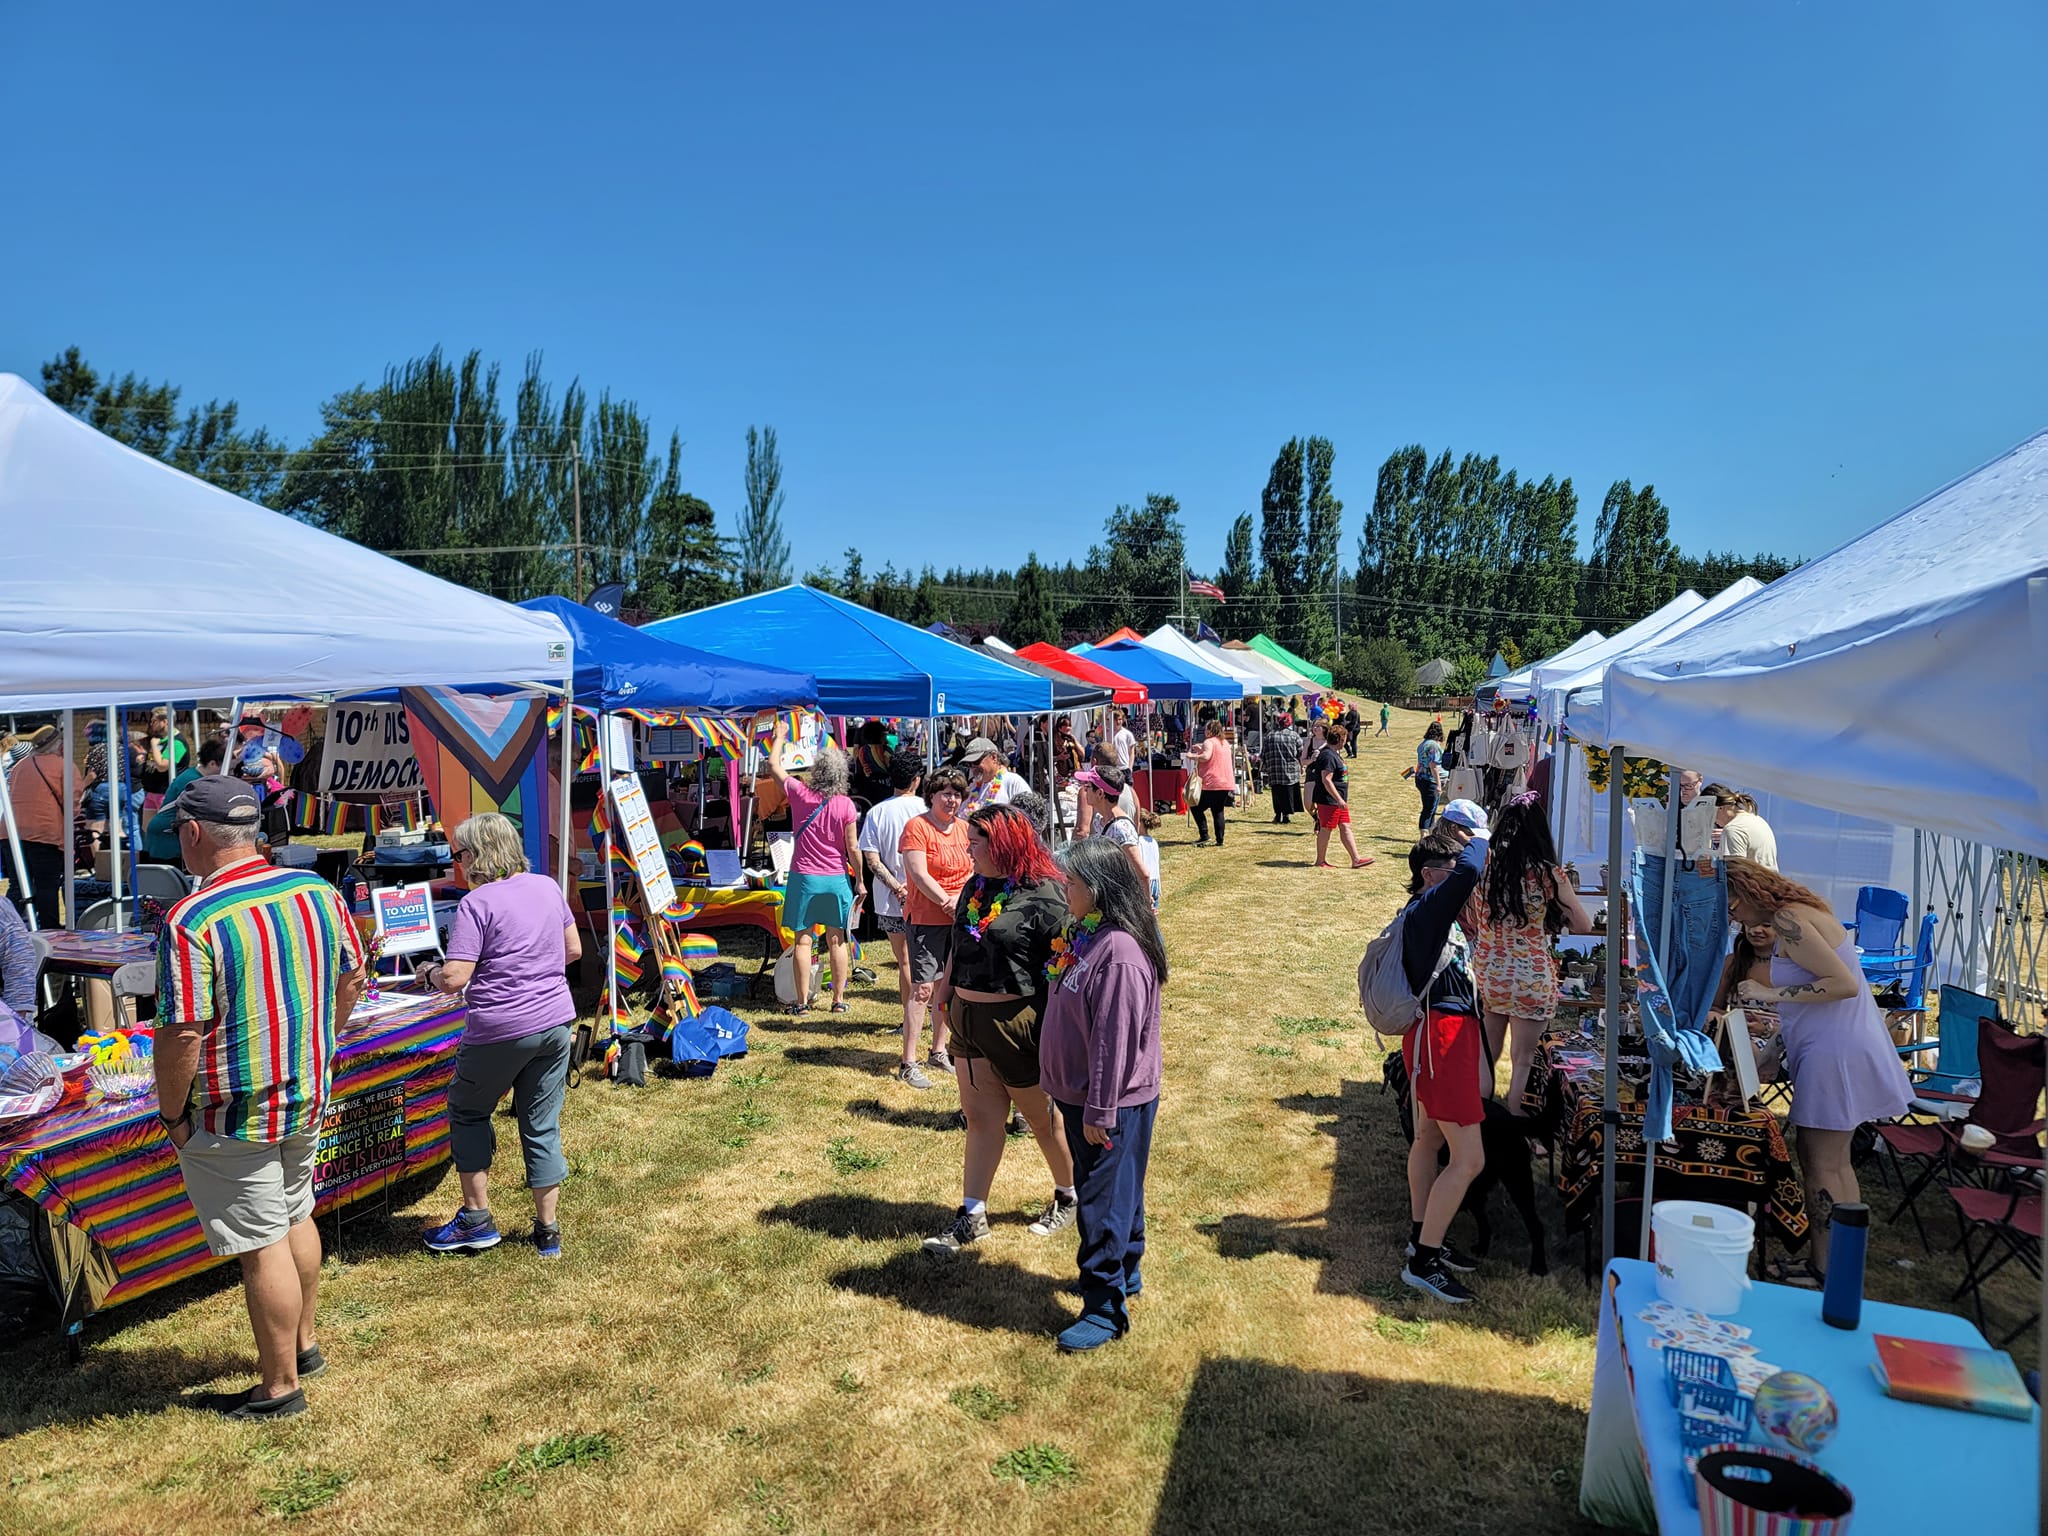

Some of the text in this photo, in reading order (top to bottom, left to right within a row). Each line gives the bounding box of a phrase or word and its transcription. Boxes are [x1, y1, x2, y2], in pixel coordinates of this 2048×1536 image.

[335, 709, 410, 745] 10th DIS
[328, 757, 425, 791] DEMOCR
[385, 907, 399, 916] TO
[400, 904, 425, 914] VOTE
[321, 1095, 403, 1130] ACK LIVES MATTER
[325, 1105, 337, 1116] HIS
[365, 1094, 376, 1104] WE
[314, 1125, 404, 1167] SCIENCE IS REAL
[329, 1127, 361, 1147] HUMAN
[363, 1124, 370, 1136] IS
[372, 1114, 404, 1133] ILLEGAL
[314, 1137, 404, 1183] LOVE IS LOVE
[314, 1154, 403, 1192] KINDNESS IS EVERYTHING
